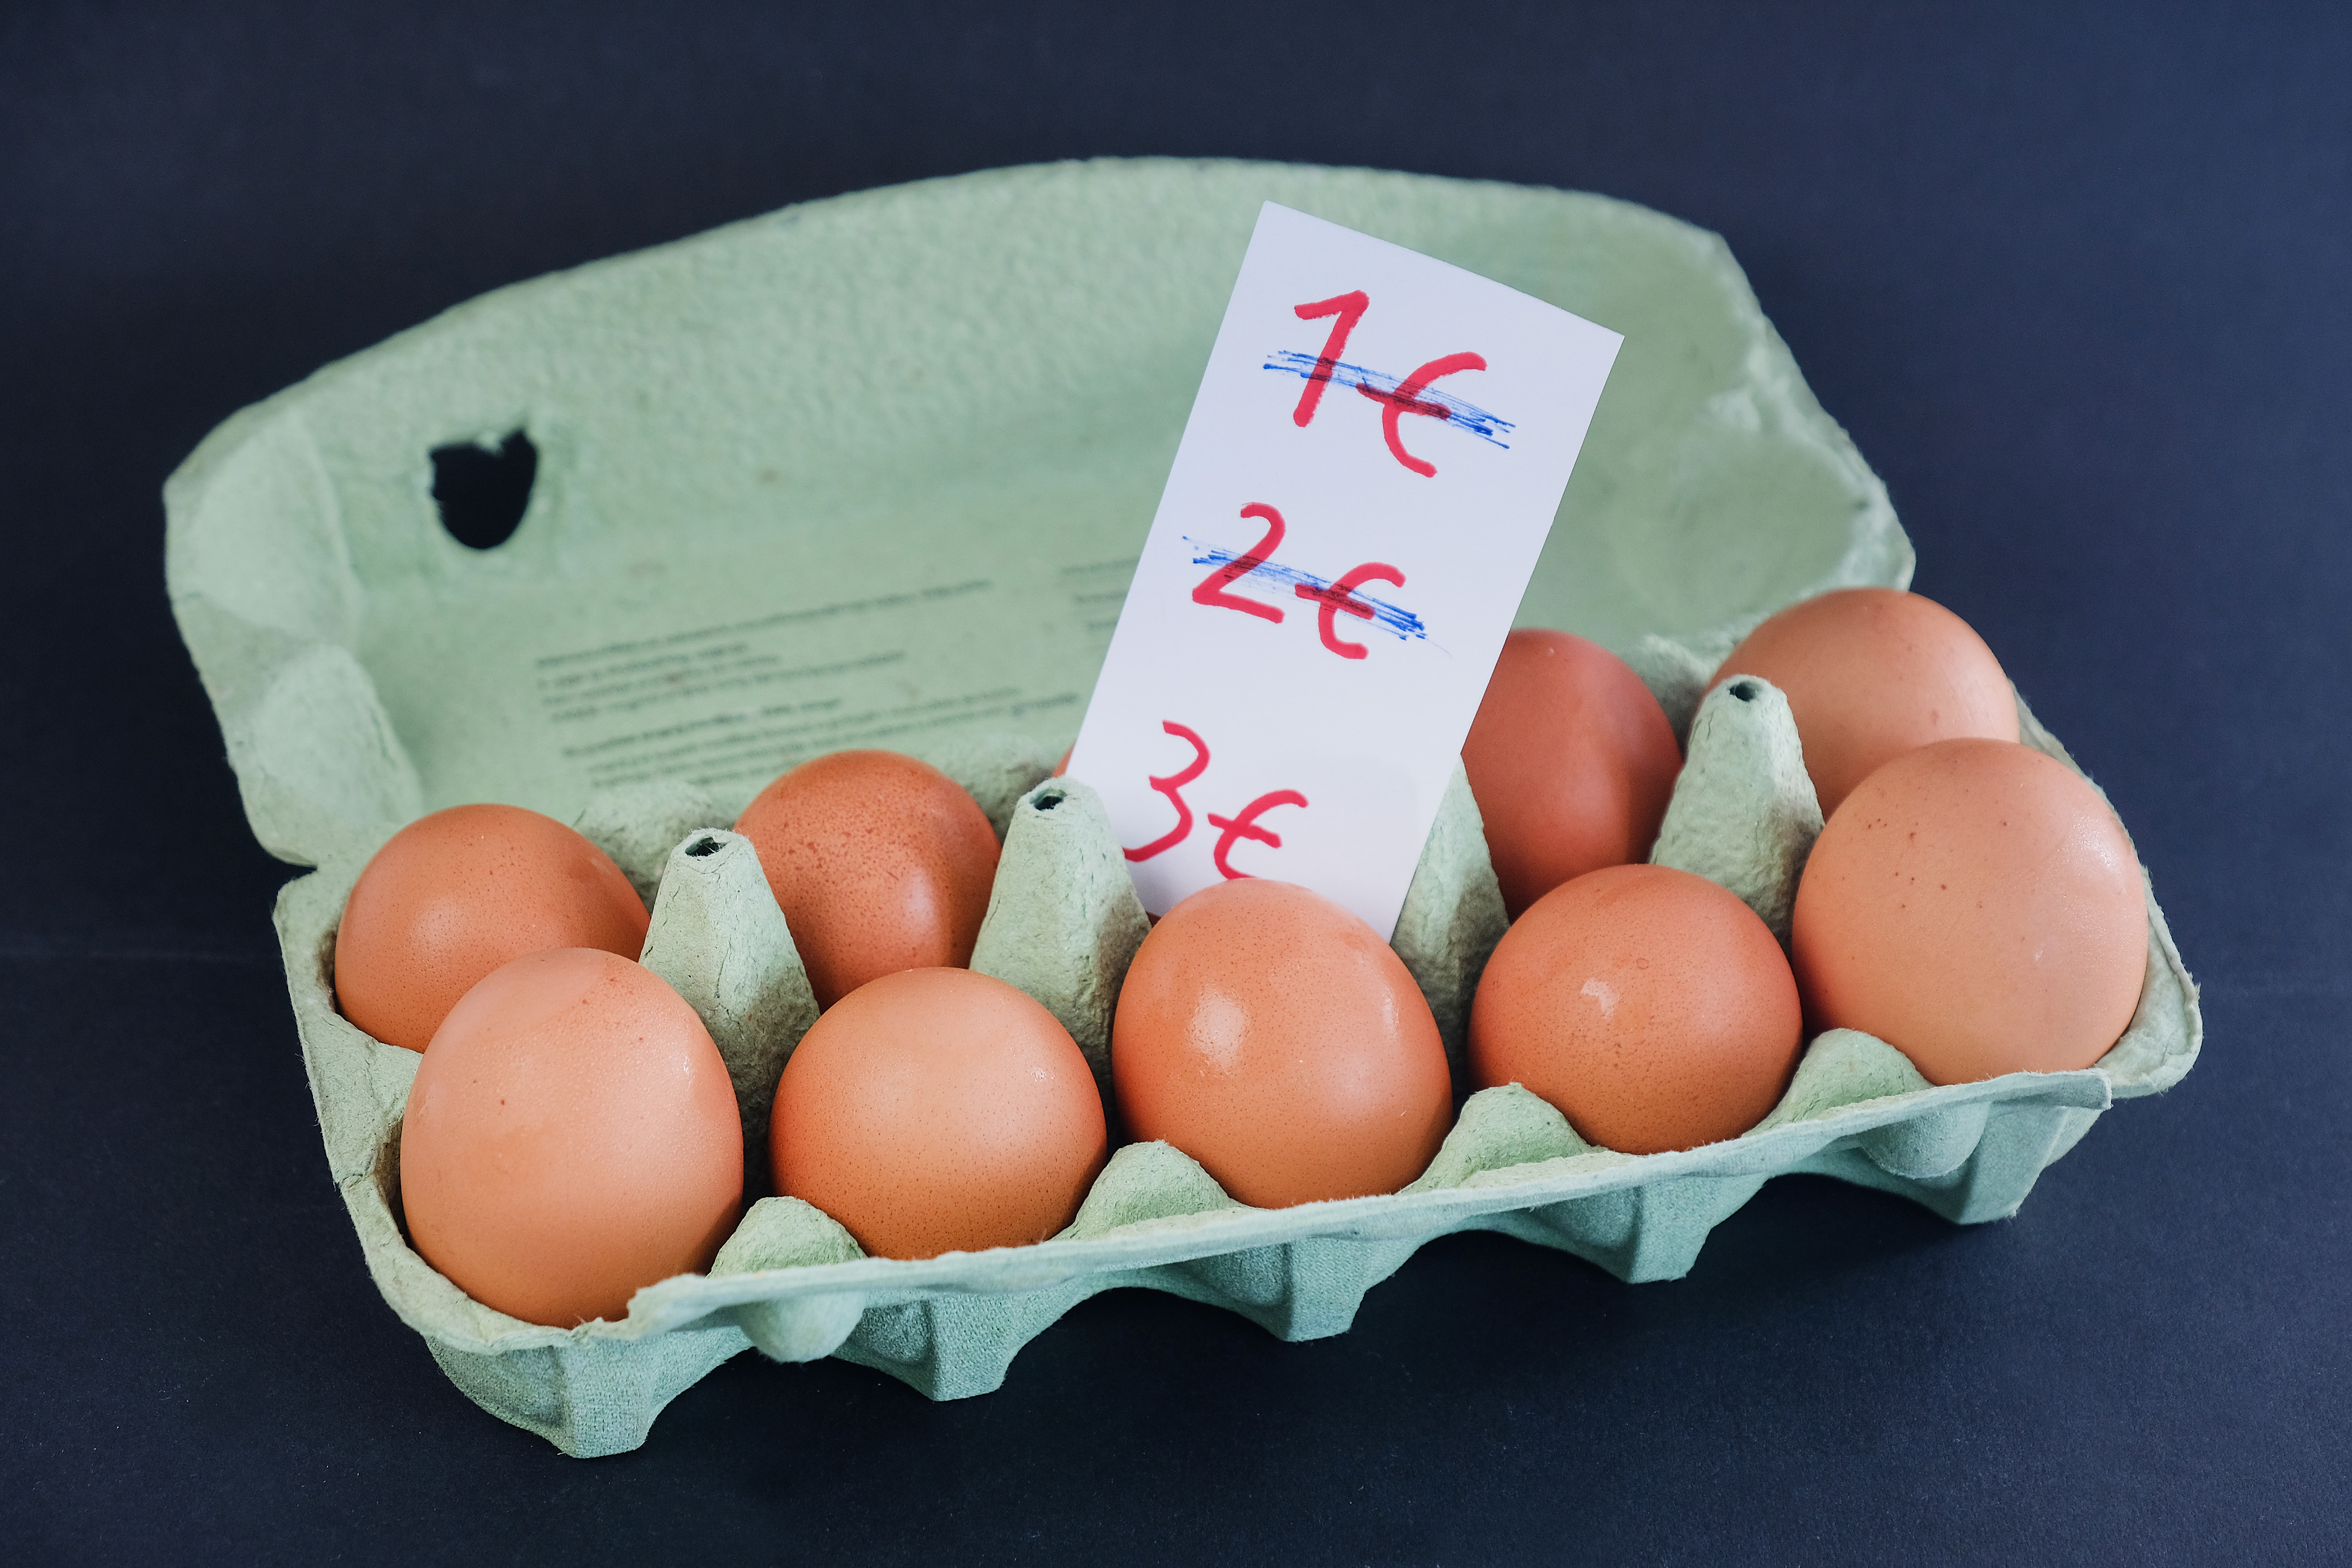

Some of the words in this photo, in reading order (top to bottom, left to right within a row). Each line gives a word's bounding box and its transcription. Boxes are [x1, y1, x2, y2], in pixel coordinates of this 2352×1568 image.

[1292, 289, 1488, 479] 1€
[1191, 502, 1407, 660] 2€
[1122, 720, 1309, 880] 3€
